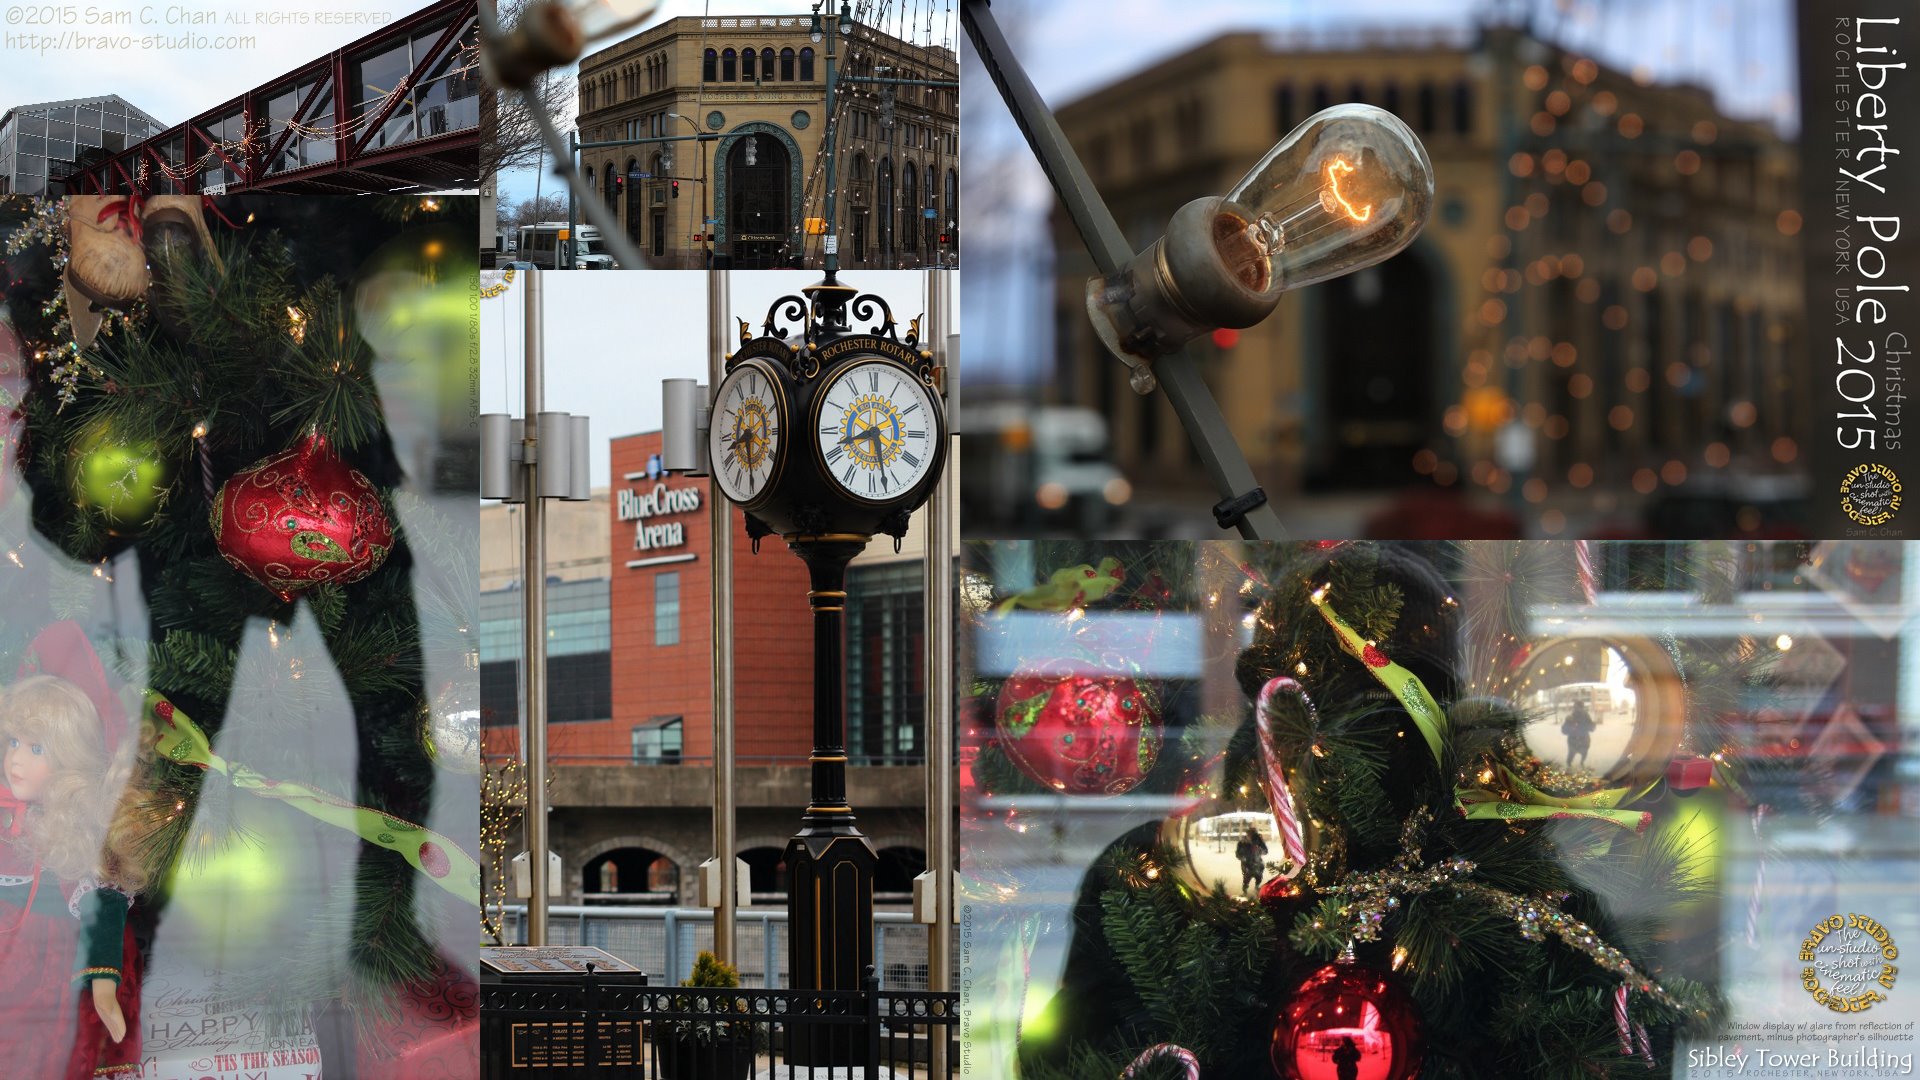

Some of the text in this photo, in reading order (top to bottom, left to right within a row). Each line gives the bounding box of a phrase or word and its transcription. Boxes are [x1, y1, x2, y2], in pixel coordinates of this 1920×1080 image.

[821, 338, 919, 366] ROCHESTER ROTARY
[860, 402, 888, 412] ROARY
[850, 442, 898, 462] INTERNATONAL
[618, 483, 699, 521] BlueCross
[633, 520, 684, 550] Arena
[151, 1011, 259, 1040] HAPPY
[164, 1031, 241, 1053] Holidays
[240, 1051, 270, 1070] THE
[272, 1046, 321, 1067] SEASON
